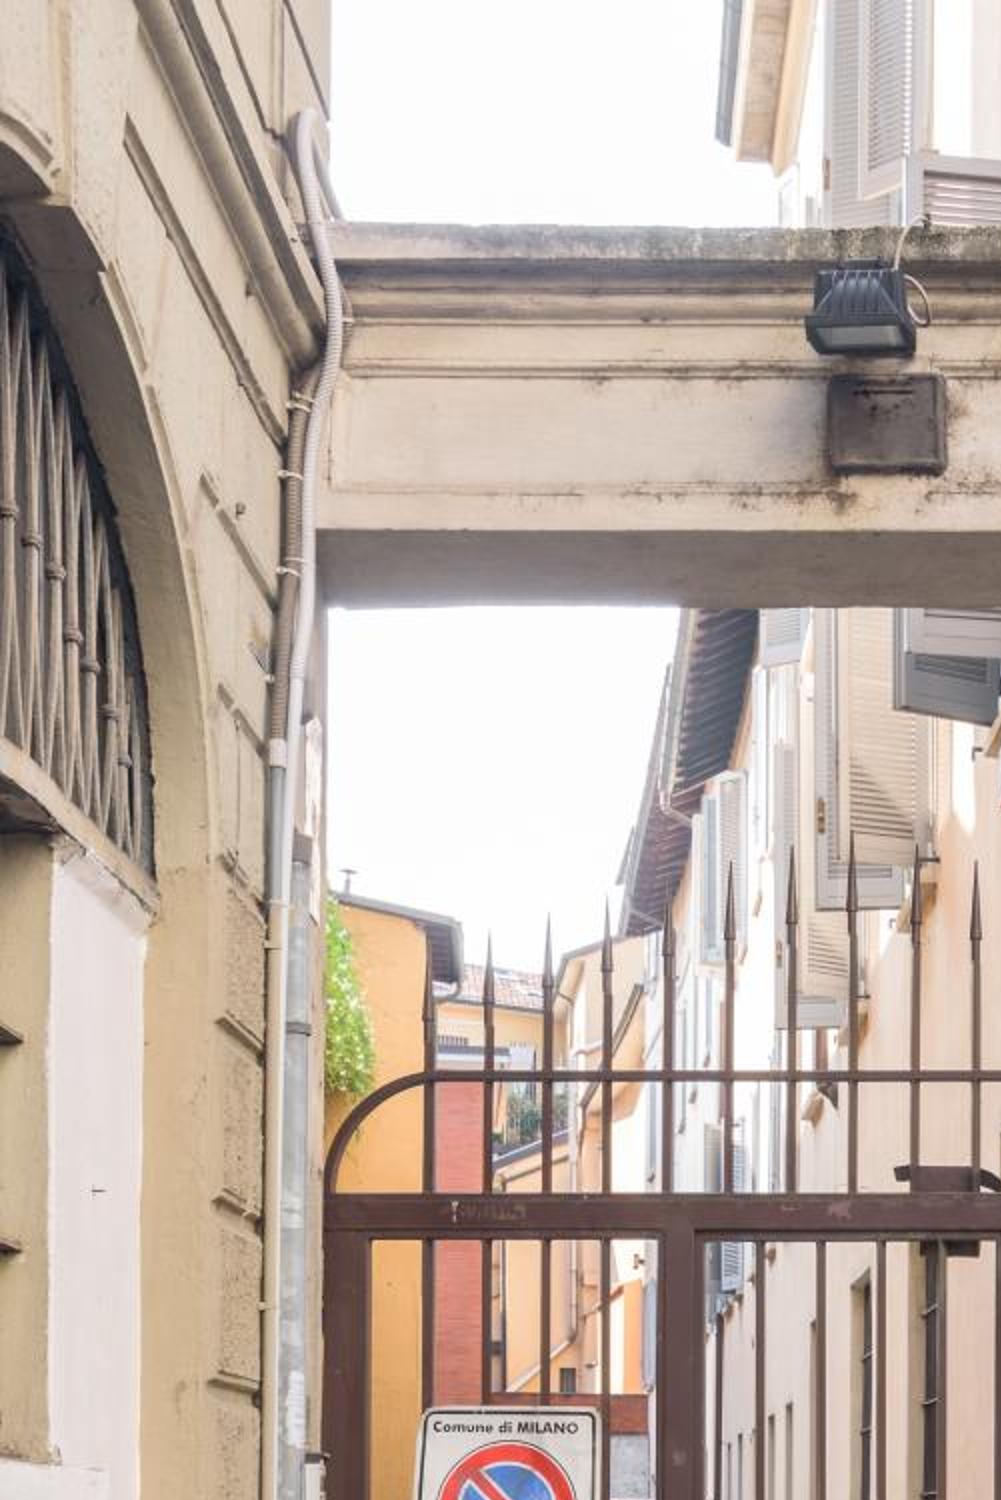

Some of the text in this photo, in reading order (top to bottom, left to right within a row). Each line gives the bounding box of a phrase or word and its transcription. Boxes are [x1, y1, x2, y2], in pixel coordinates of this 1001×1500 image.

[433, 1420, 579, 1434] Comune di MILANO
